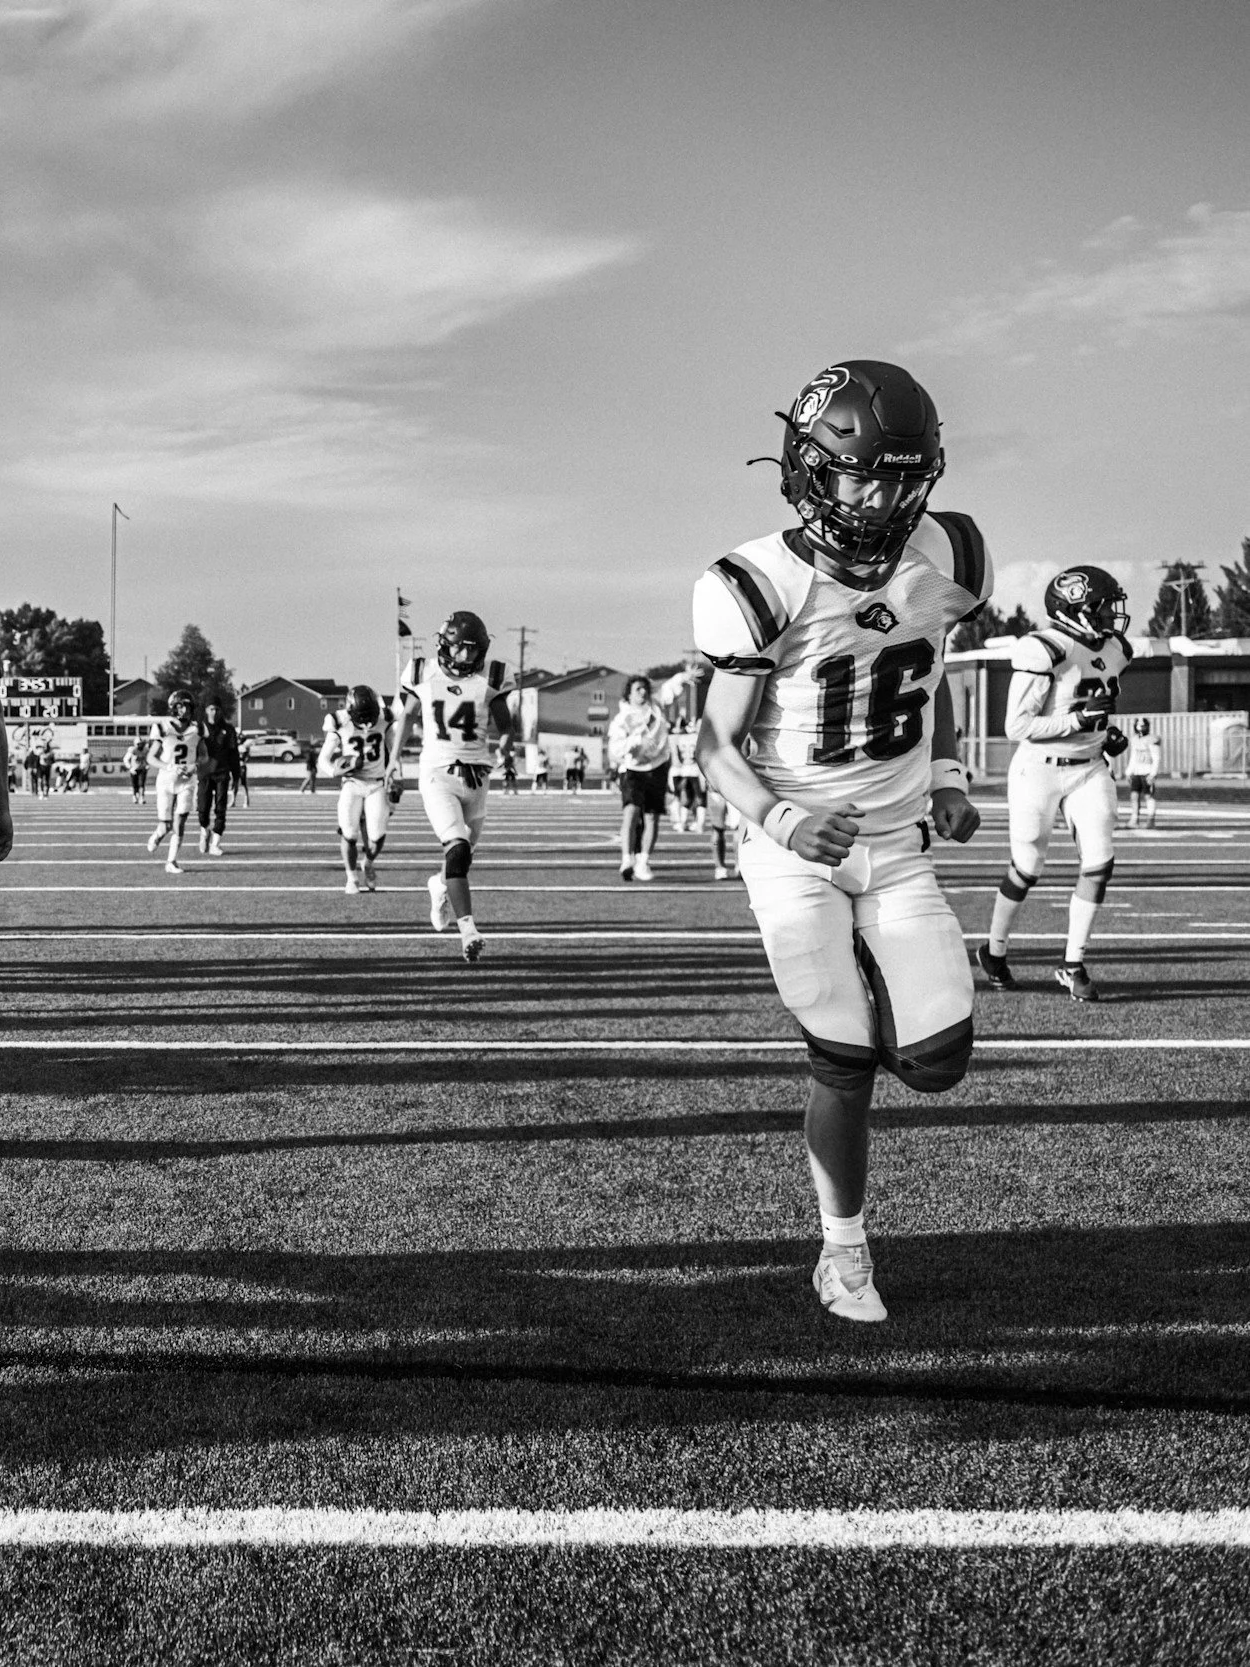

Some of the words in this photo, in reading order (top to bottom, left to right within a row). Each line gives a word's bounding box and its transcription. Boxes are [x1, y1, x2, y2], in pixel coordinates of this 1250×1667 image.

[883, 453, 922, 464] Riddell
[73, 685, 81, 698] 0
[806, 637, 935, 767] 16
[432, 700, 478, 741] 14
[174, 744, 188, 764] 2
